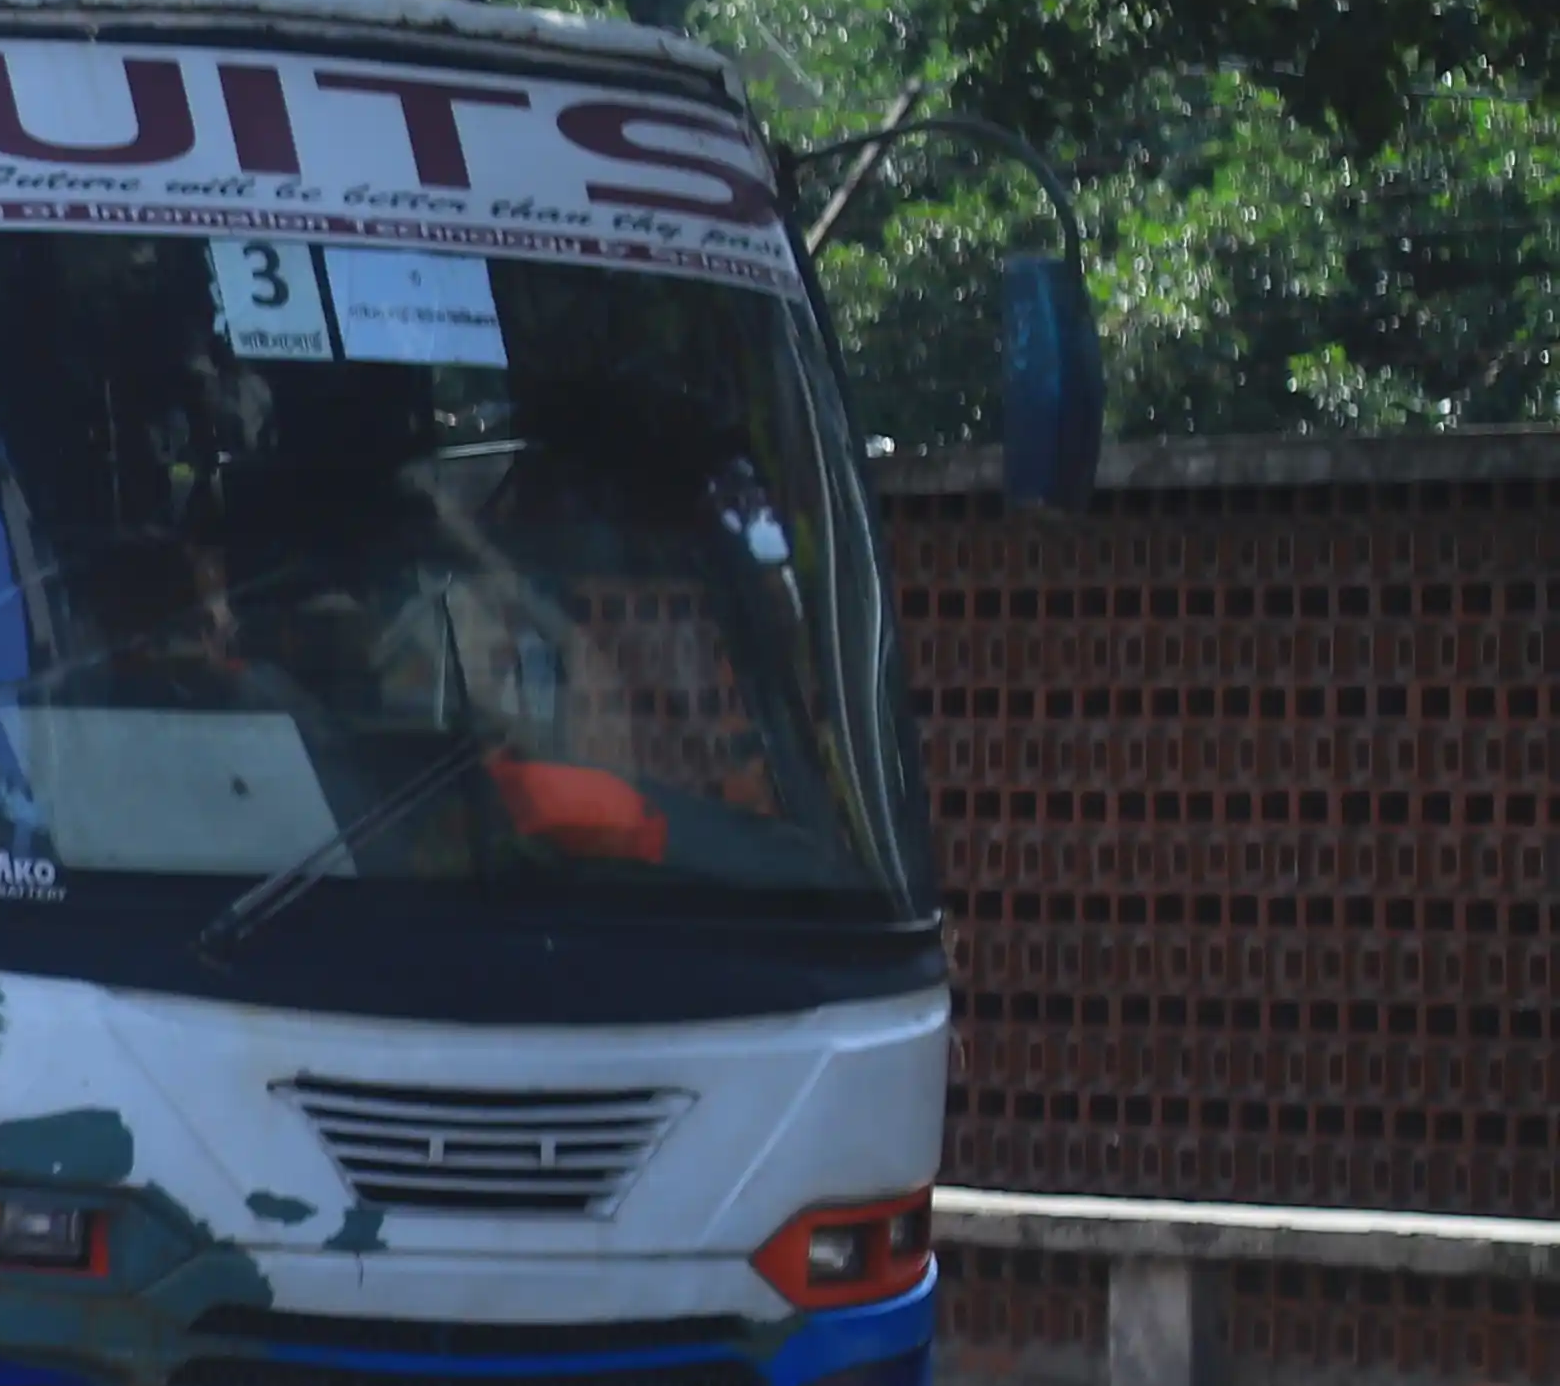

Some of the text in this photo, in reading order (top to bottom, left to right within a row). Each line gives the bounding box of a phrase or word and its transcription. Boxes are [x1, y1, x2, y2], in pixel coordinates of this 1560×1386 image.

[276, 176, 321, 202] be
[343, 182, 467, 213] better
[491, 196, 591, 225] than
[613, 213, 683, 243] thy
[242, 240, 289, 310] 3
